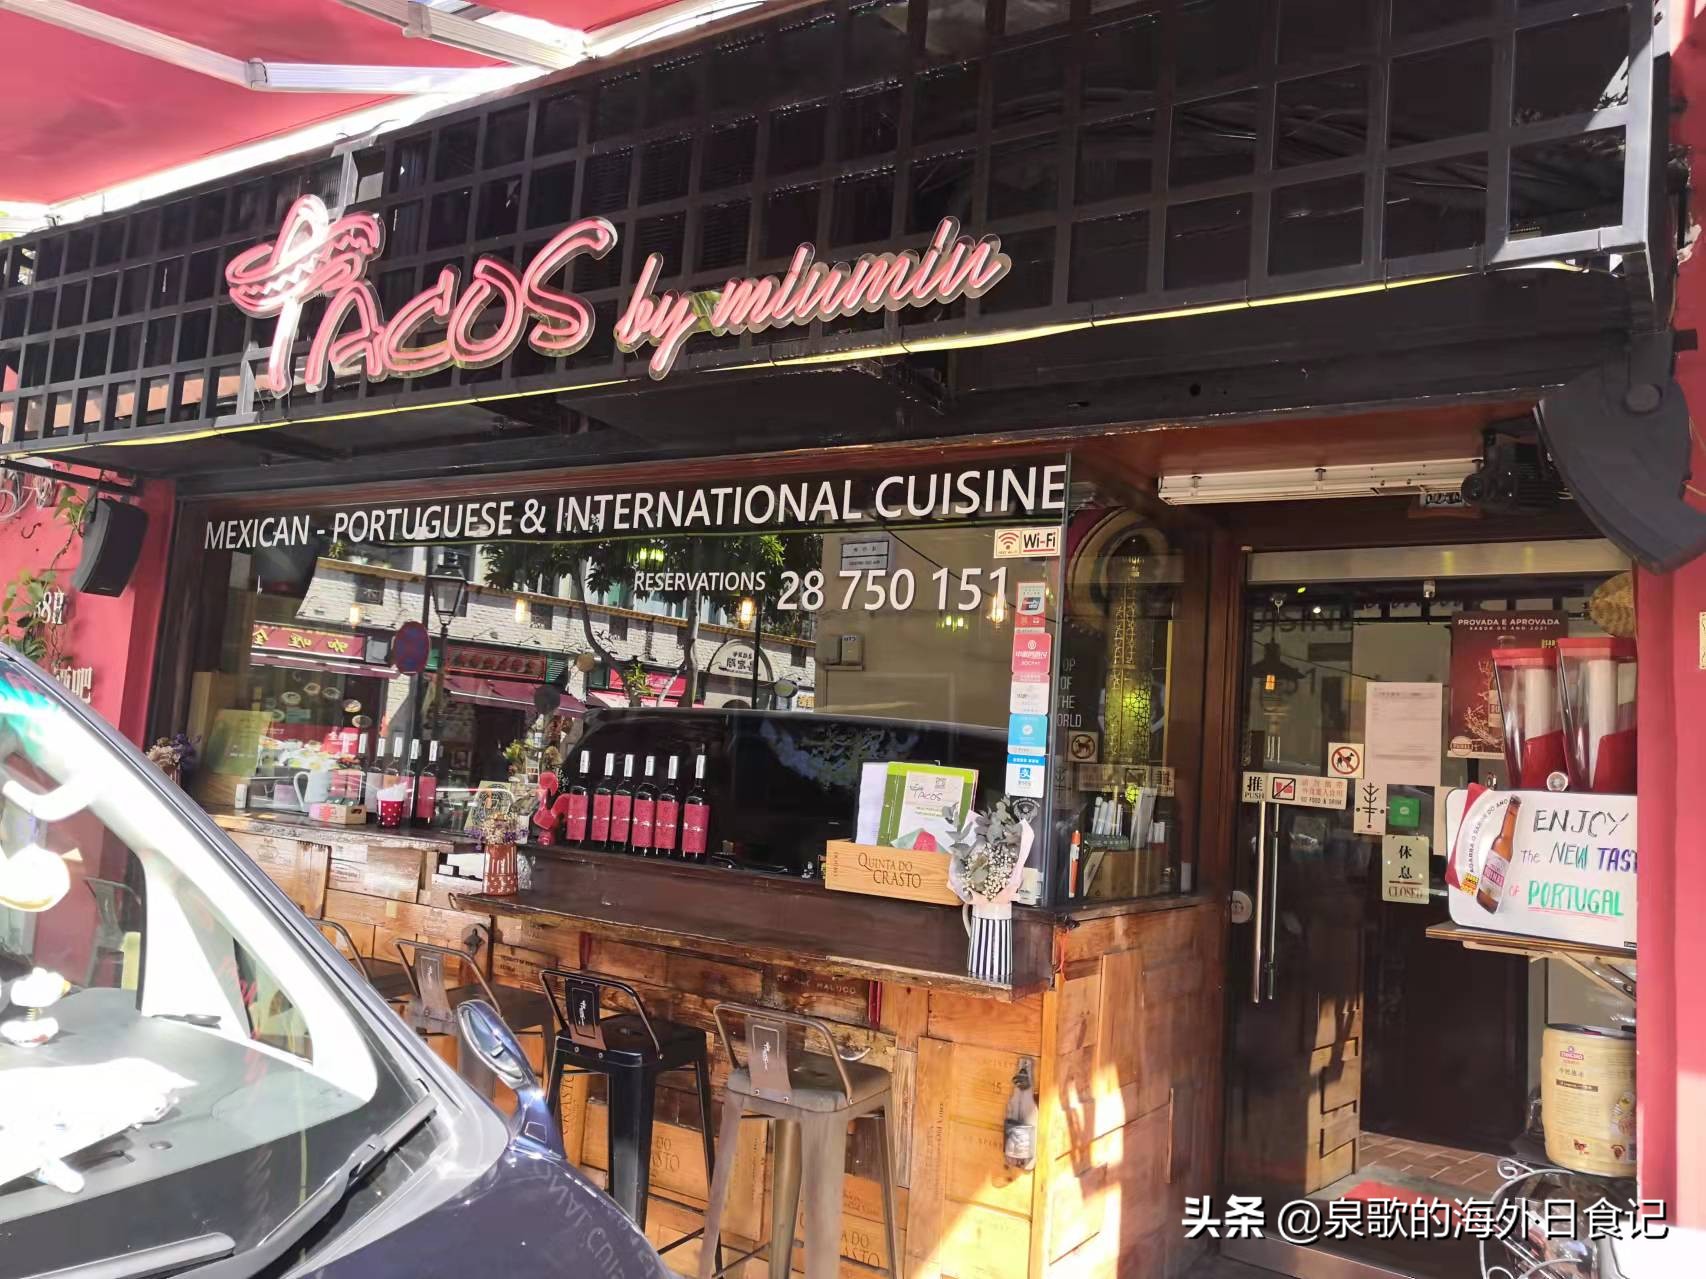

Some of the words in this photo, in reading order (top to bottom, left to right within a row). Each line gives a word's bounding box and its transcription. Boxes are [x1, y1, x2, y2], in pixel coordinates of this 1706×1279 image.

[226, 194, 618, 396] TACOS
[614, 253, 699, 380] by
[204, 515, 310, 549] MEXICAN
[333, 501, 514, 543] PORTUGUESE
[519, 498, 547, 535] &
[555, 479, 863, 533] INTERNATIONAL
[875, 464, 1068, 519] CUISINE
[1023, 532, 1057, 549] Wi-Fi
[634, 571, 766, 592] RESERVATIONS
[776, 570, 825, 611] 28
[839, 568, 916, 611] 750
[931, 566, 1007, 611] 151
[1458, 618, 1499, 626] PROVADA
[1501, 618, 1507, 626] E
[1509, 618, 1560, 626] APROVADA
[1057, 714, 1082, 728] ORLD
[1247, 776, 1263, 792] 推
[1244, 791, 1264, 799] PUSH
[858, 852, 896, 872] QUINTA
[898, 861, 913, 872] DO
[1398, 845, 1412, 880] 休息
[1550, 841, 1589, 870] NEW
[872, 869, 922, 889] CRASTO
[1528, 879, 1624, 916] PORTUGAL
